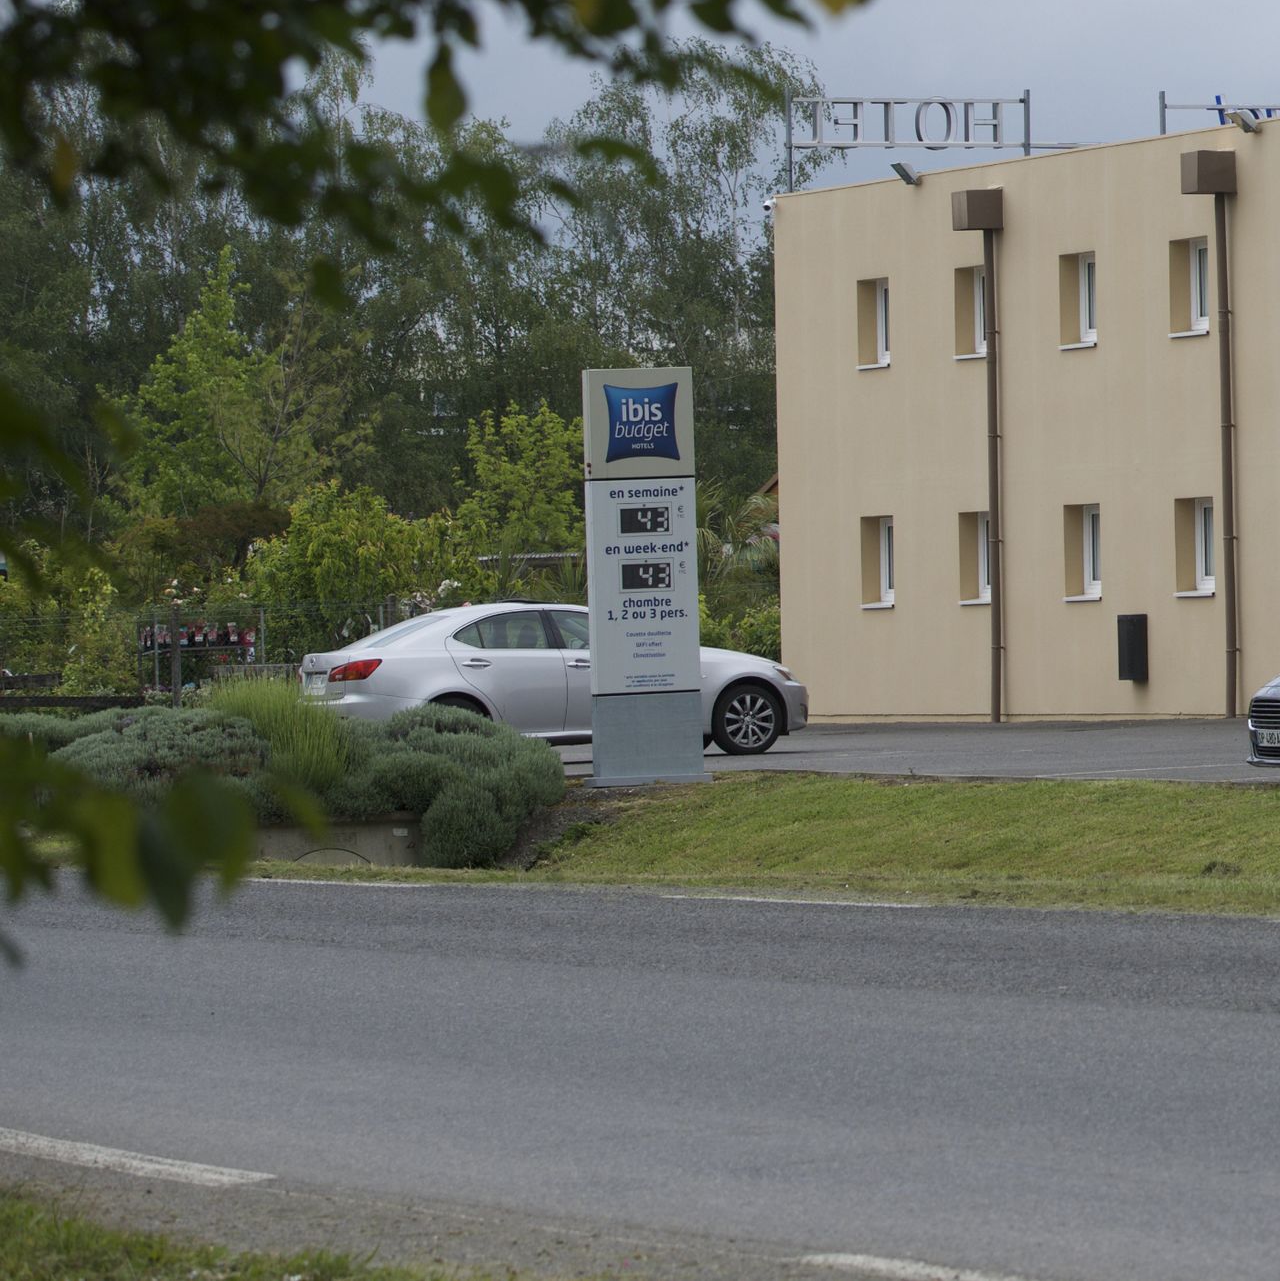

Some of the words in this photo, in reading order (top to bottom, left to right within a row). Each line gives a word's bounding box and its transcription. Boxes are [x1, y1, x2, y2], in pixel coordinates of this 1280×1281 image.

[621, 397, 663, 422] ibis
[614, 420, 670, 441] budget
[609, 488, 625, 499] en
[637, 506, 668, 532] 43
[605, 545, 621, 556] en
[639, 563, 670, 588] 43
[622, 596, 672, 609] chambre
[621, 609, 629, 620] 2
[632, 610, 646, 620] ou
[649, 608, 657, 619] 3
[660, 608, 688, 621] pers.
